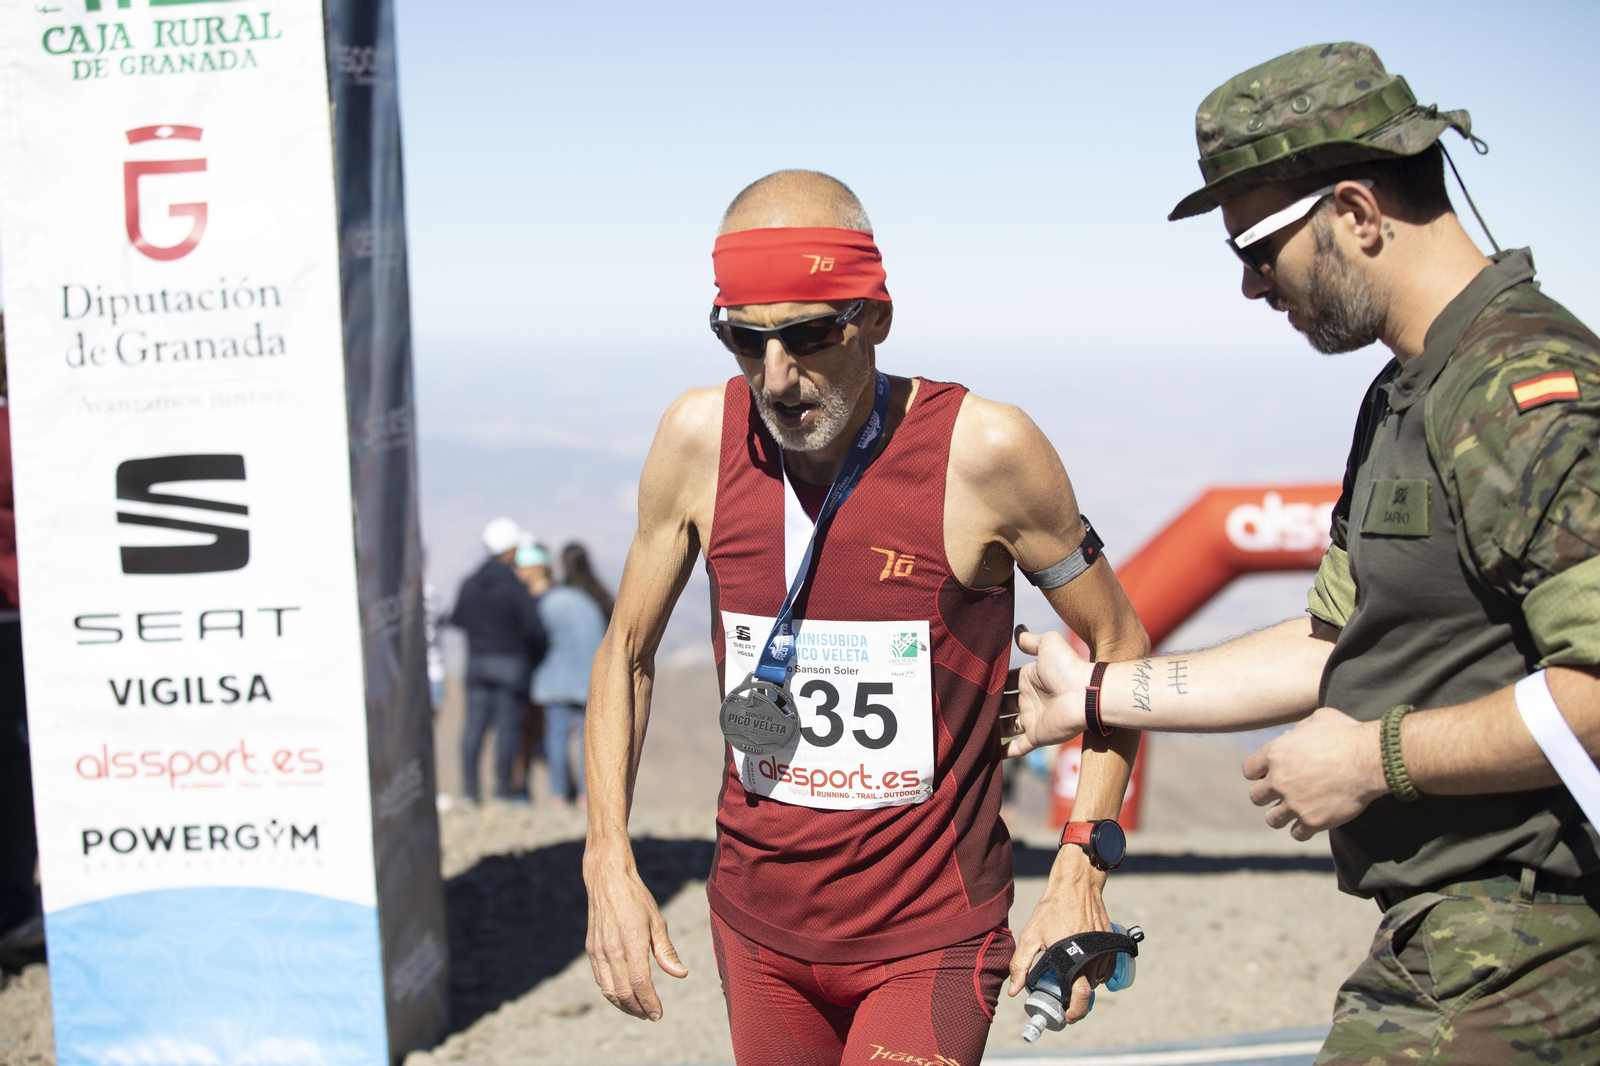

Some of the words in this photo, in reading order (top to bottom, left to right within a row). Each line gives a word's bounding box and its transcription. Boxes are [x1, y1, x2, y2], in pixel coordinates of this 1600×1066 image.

[42, 22, 135, 55] CAJA
[153, 12, 283, 49] RURAL
[71, 58, 109, 81] DE
[119, 48, 259, 77] GRANADA
[61, 276, 282, 327] Diputación
[65, 330, 107, 369] de
[115, 320, 287, 368] Granada
[73, 606, 302, 646] SEAT
[733, 641, 757, 650] SEAT
[822, 648, 869, 663] VELETA
[795, 664, 831, 675] Sansón
[833, 666, 859, 675] Soler
[109, 674, 272, 707] VIGILSA
[727, 713, 751, 727] PICO
[753, 719, 787, 735] VELETA
[757, 680, 898, 750] 35
[76, 739, 324, 789] alssport.es
[758, 755, 921, 797] alssport.es
[816, 790, 850, 799] RUNNING
[856, 792, 878, 800] TRAIL
[883, 789, 921, 799] OUTDOOR
[82, 819, 320, 856] POWERGYM
